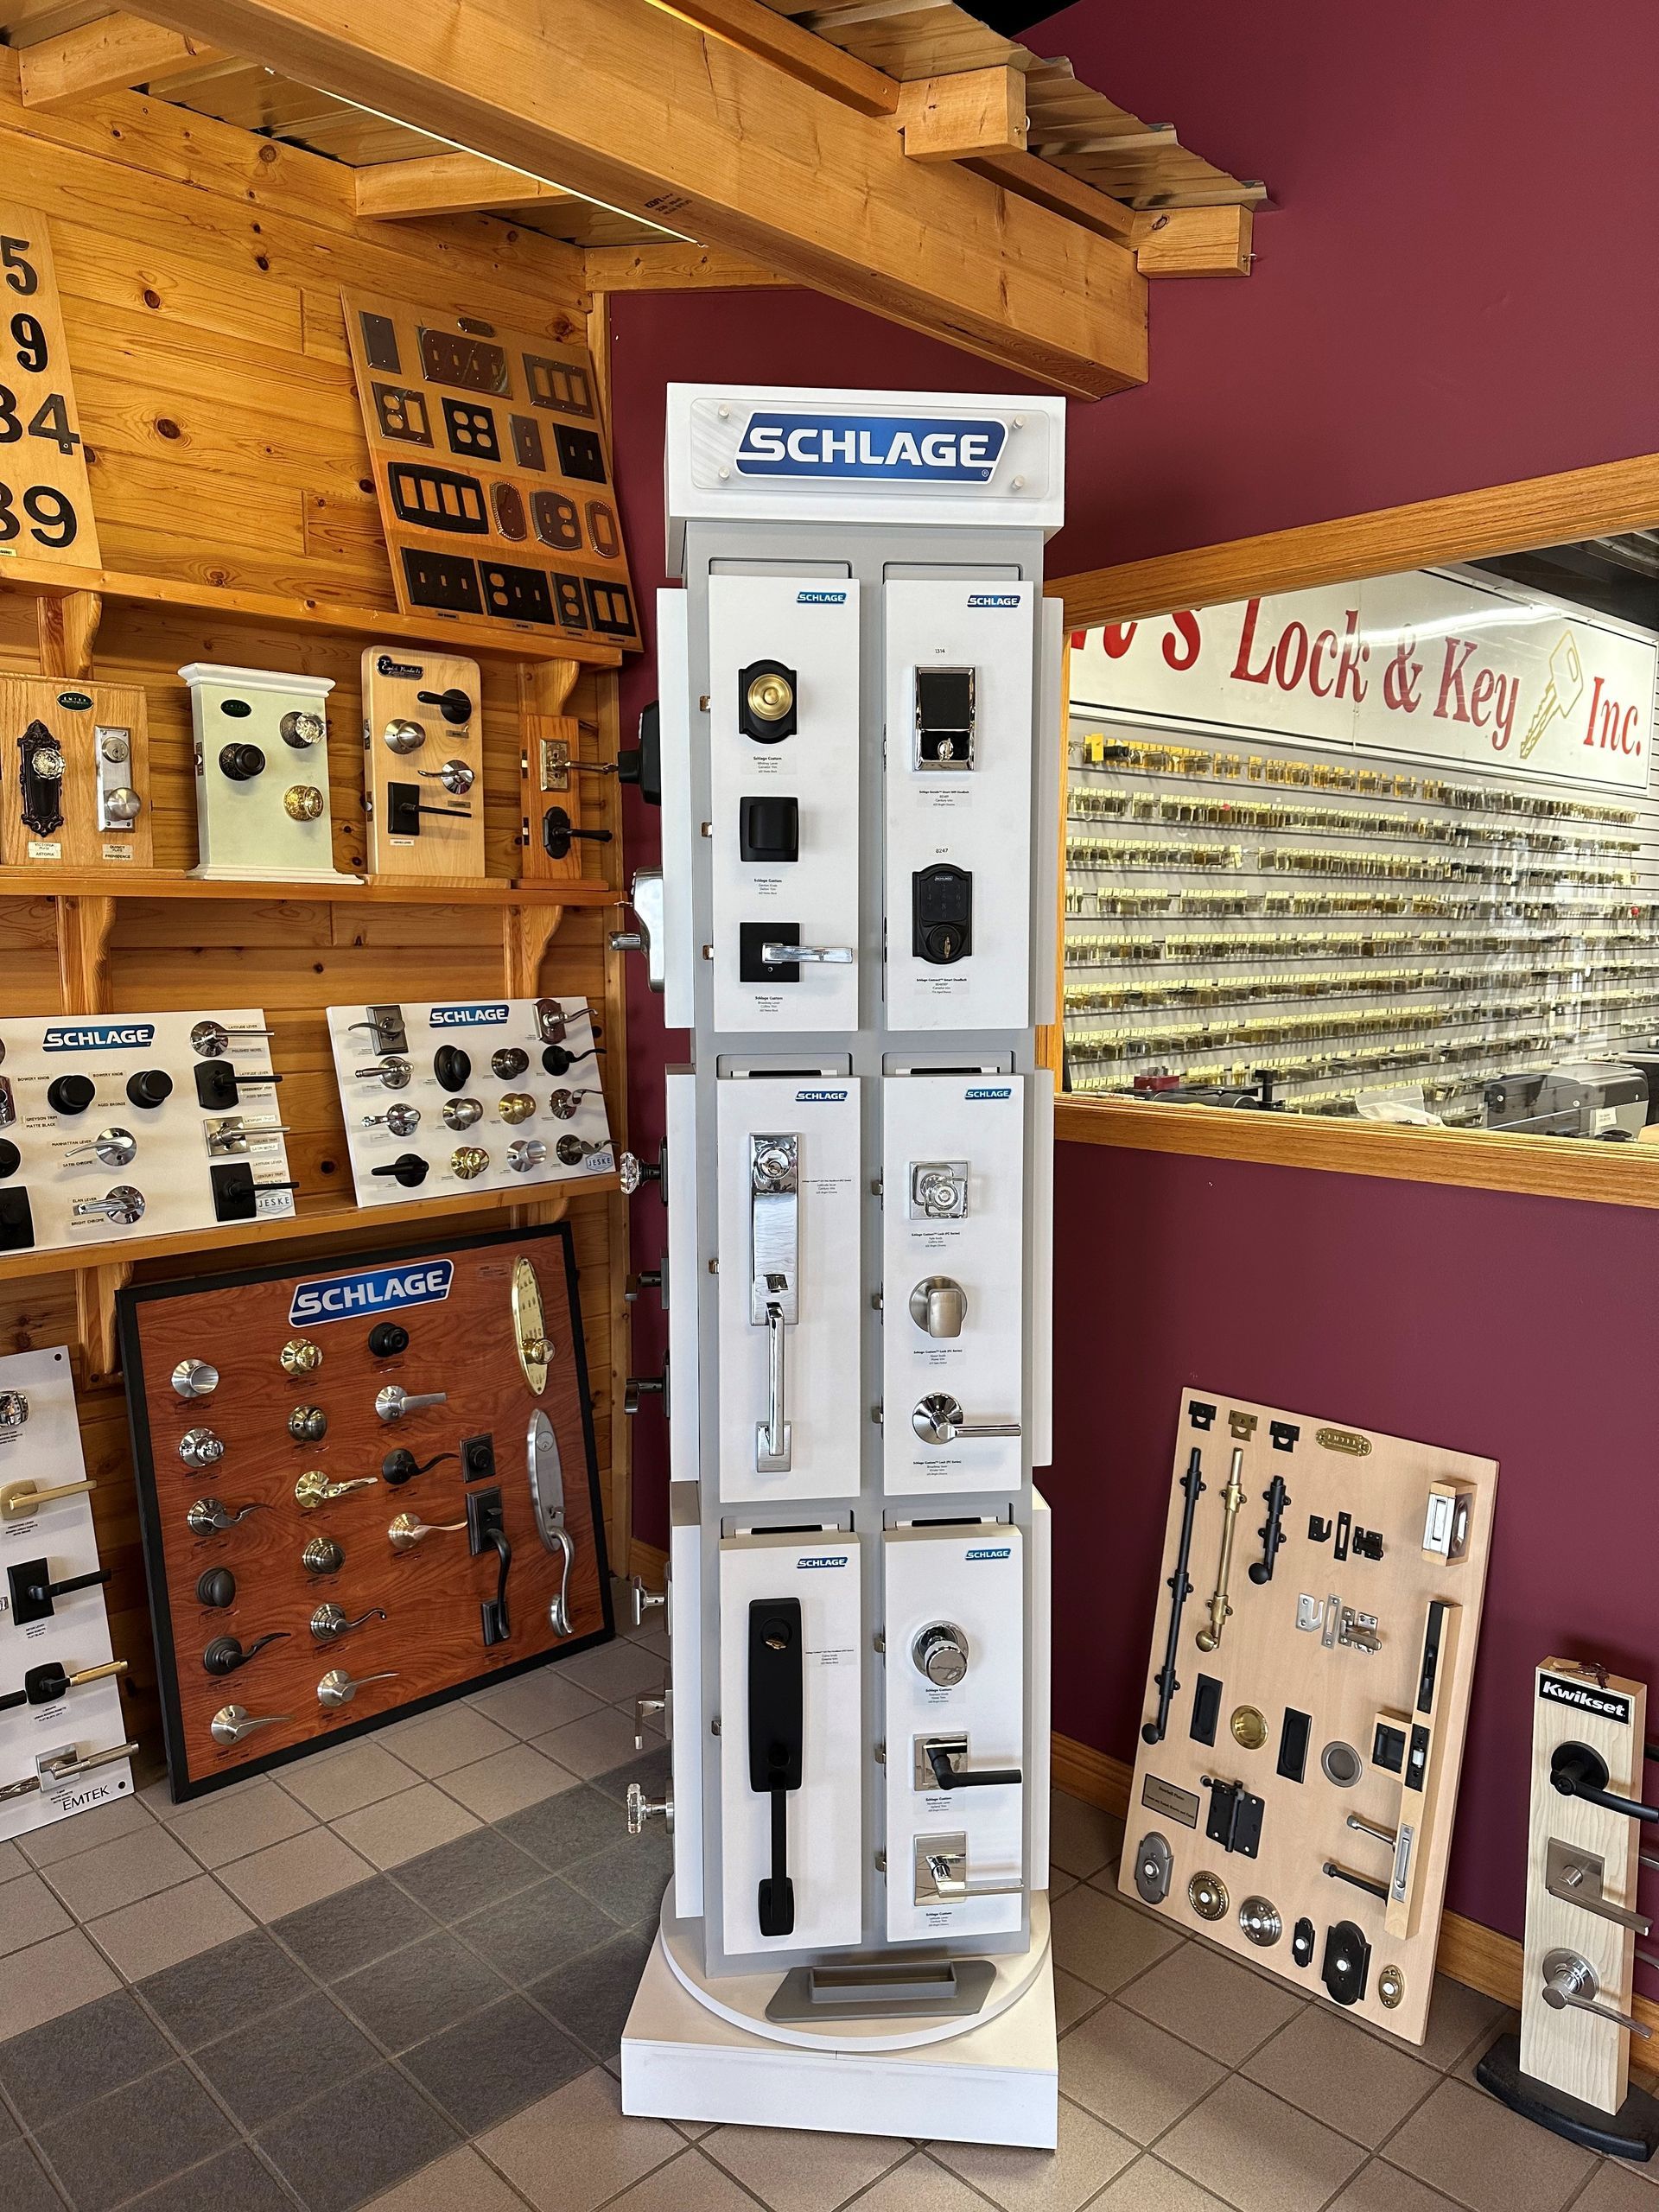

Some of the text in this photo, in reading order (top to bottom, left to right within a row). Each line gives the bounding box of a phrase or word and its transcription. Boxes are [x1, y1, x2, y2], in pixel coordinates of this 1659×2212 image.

[1, 235, 38, 296] 5
[10, 313, 48, 372] 9
[735, 427, 997, 468] SCHLAGE
[797, 593, 845, 603] SCHLAGE
[967, 596, 1019, 606] SCHLAGE
[1230, 599, 1368, 703] Lock
[1384, 624, 1424, 714] &
[1433, 637, 1521, 752] Key
[1583, 677, 1643, 757] Inc.
[429, 1008, 507, 1024] SCHLAGE
[43, 1029, 153, 1047] SCHLAGE
[796, 1091, 847, 1100] SCHLAGE
[965, 1089, 1011, 1098] SCHLAGE
[588, 1157, 611, 1166] JESKE
[258, 1196, 290, 1208] JESKE
[291, 1269, 449, 1319] SCHLAGE
[797, 1557, 847, 1567] SCHLAGE
[965, 1549, 1011, 1560] SCHLAGE
[1543, 1681, 1625, 1717] Kwikset
[63, 1784, 110, 1811] EMTEK
